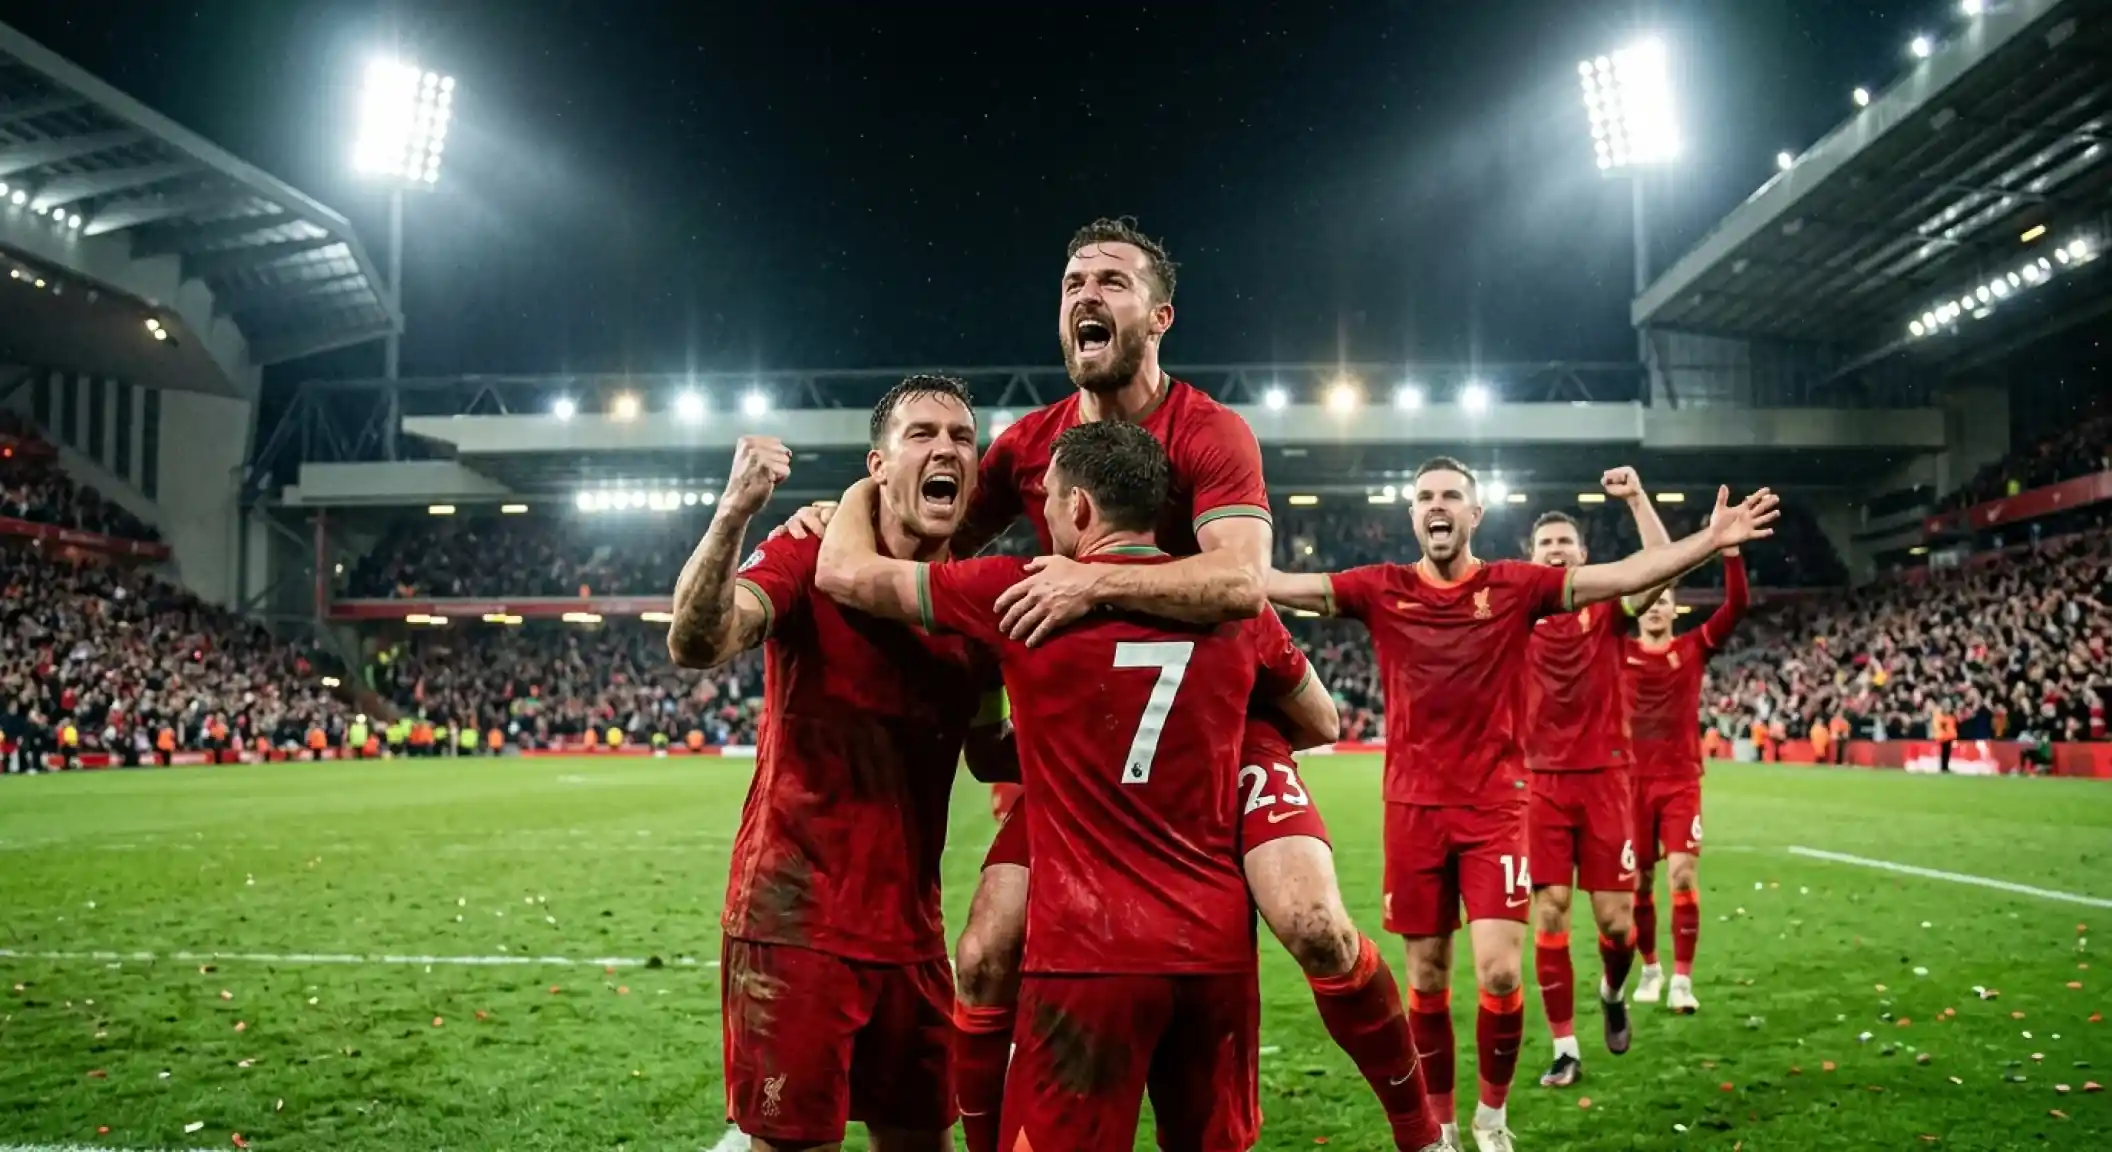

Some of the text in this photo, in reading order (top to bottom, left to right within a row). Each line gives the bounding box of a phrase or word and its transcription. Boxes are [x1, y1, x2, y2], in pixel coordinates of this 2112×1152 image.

[1113, 642, 1194, 784] 7
[1239, 762, 1309, 815] 23
[1500, 855, 1532, 895] 14
